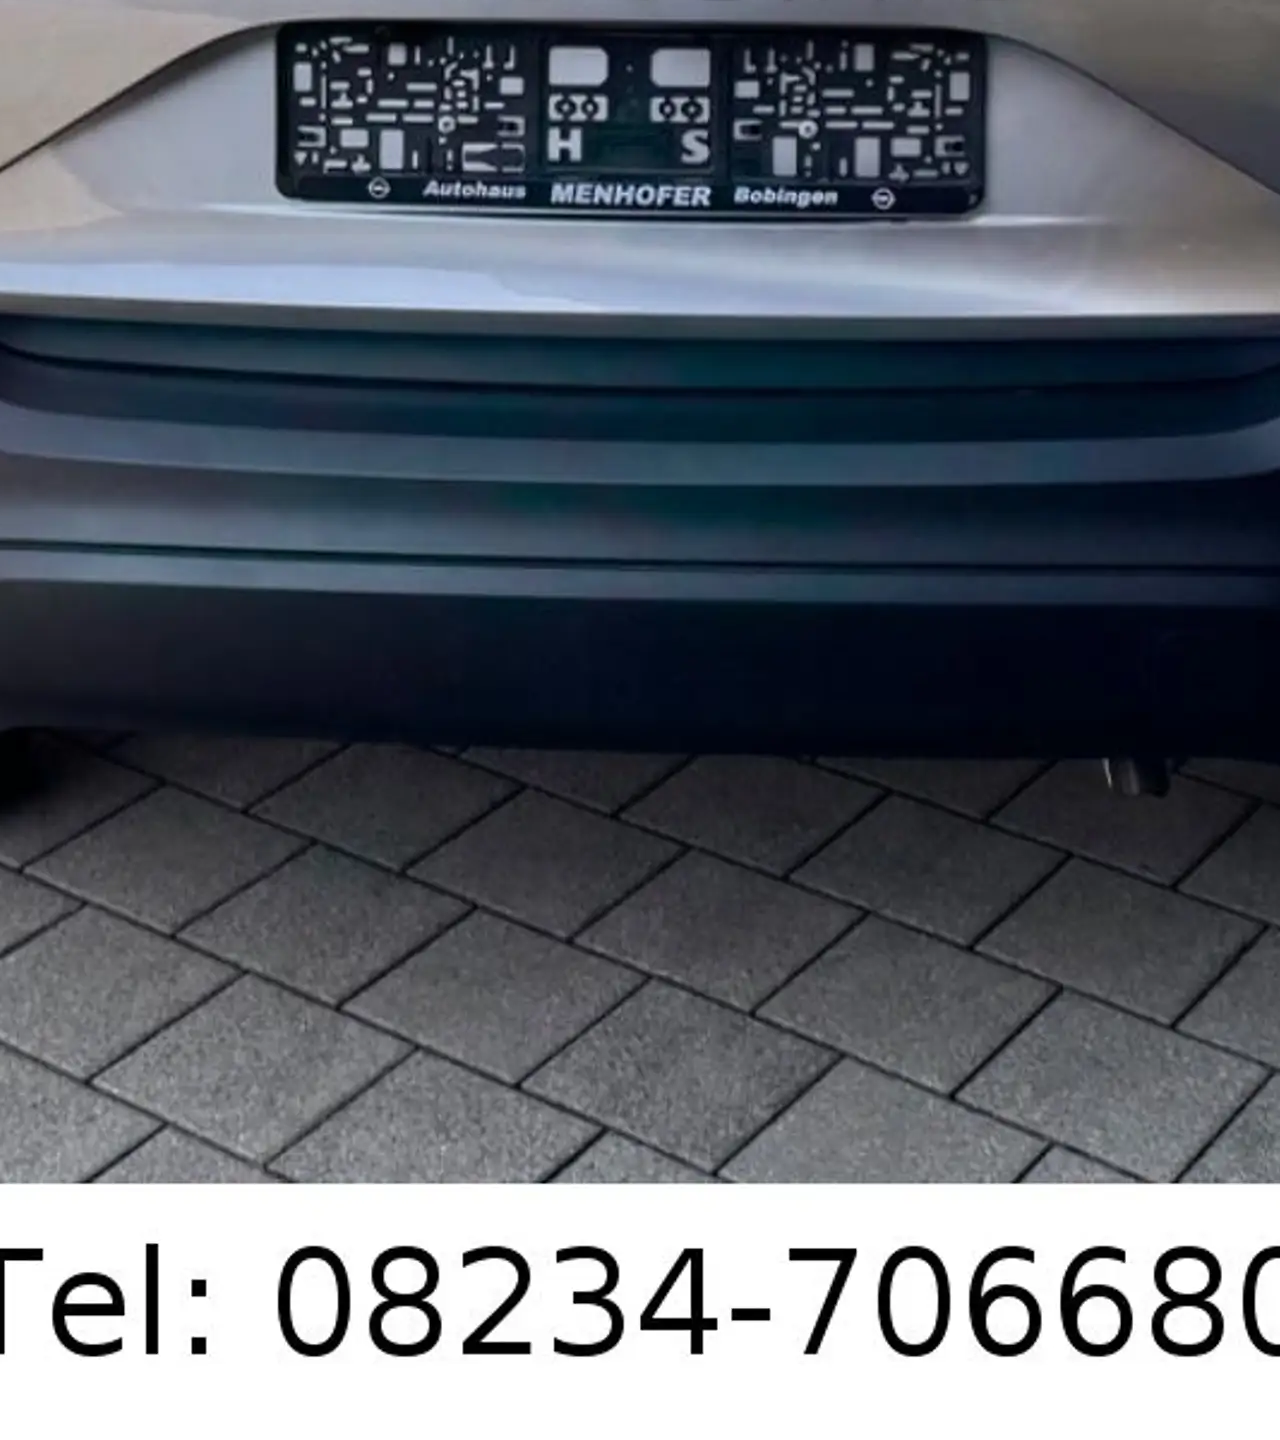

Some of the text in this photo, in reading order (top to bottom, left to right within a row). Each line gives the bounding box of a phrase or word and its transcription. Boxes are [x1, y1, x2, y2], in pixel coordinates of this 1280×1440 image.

[422, 180, 839, 211] Autohaus MENHOFER Bobingen
